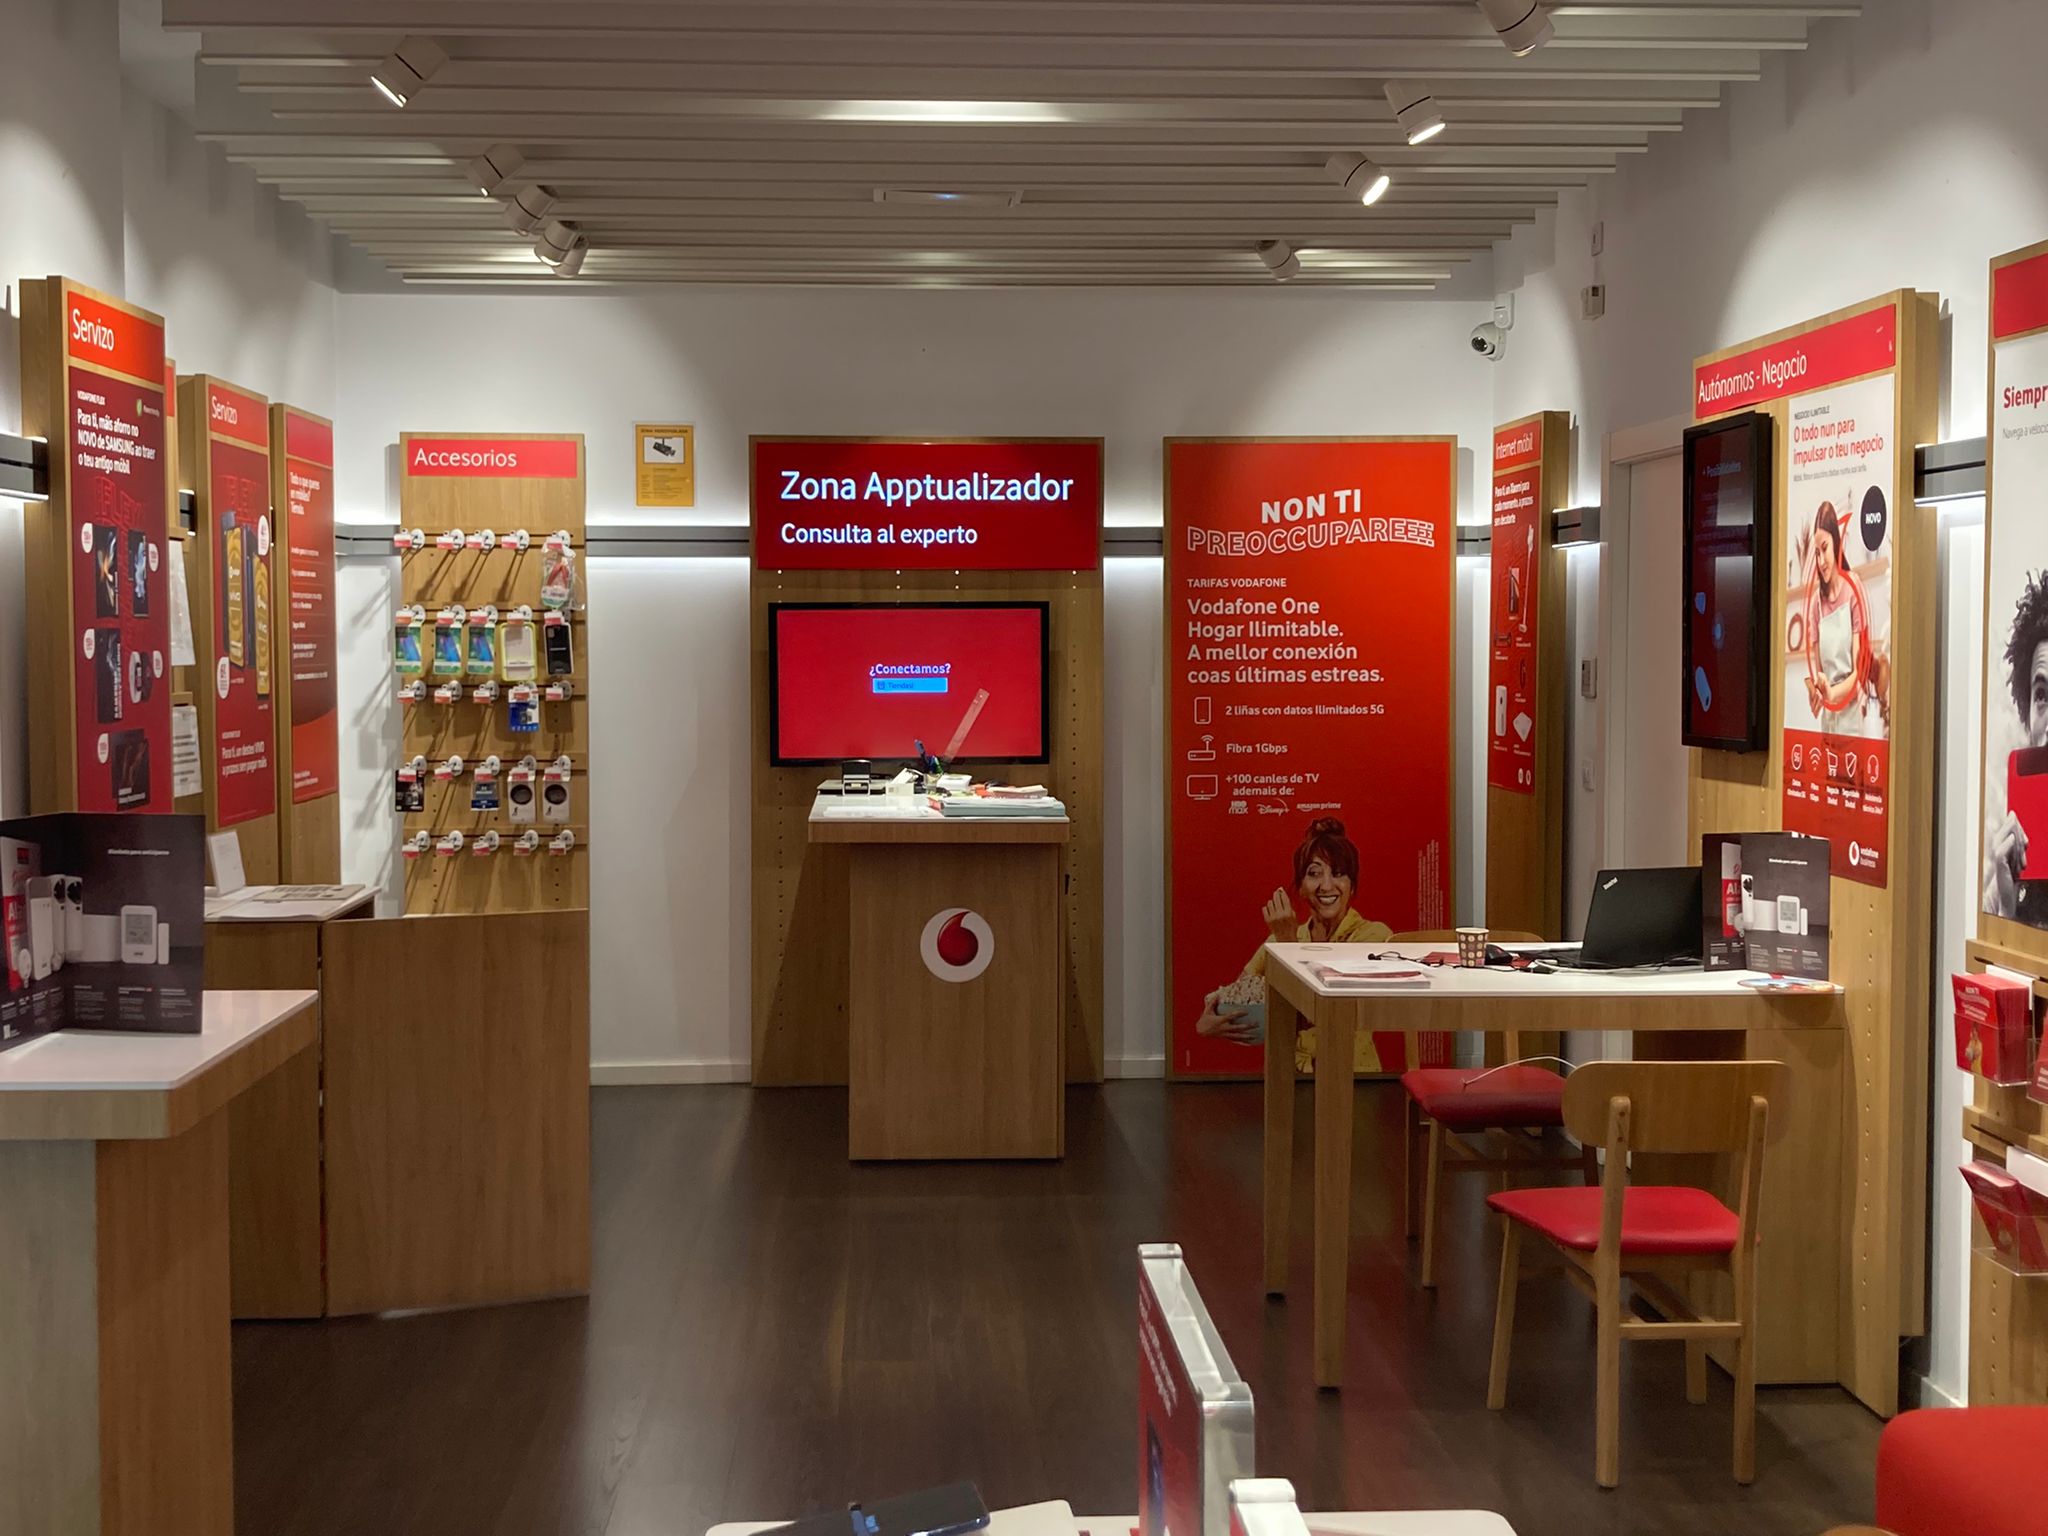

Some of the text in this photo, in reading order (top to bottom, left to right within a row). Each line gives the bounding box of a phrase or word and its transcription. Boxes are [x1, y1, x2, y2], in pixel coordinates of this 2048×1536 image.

[72, 308, 115, 351] Servizo
[1698, 370, 1754, 404] Autónomos
[1762, 350, 1807, 389] Negocio
[211, 395, 238, 425] Servizo
[1794, 408, 1811, 420] NEGOCIO
[77, 408, 91, 426] Para
[131, 425, 139, 437] no
[1794, 419, 1855, 443] O todo nun para
[78, 429, 97, 448] NOVO
[97, 434, 105, 449] de
[105, 435, 134, 456] SAMSUNG
[135, 445, 142, 457] ao
[1496, 432, 1534, 460] Internet móbil
[1793, 434, 1883, 468] impulsar o teu negocio
[78, 453, 83, 466] o
[83, 452, 94, 468] teu
[94, 455, 113, 474] antigo
[414, 448, 518, 468] Accesorios
[780, 471, 1074, 507] Zona Apptualizador
[1261, 488, 1361, 524] NON TI
[1865, 512, 1882, 524] NOVO
[781, 522, 978, 548] Consulta al experto
[1187, 578, 1287, 588] TARIFAS VODAFONE
[1187, 598, 1320, 615] Vodafone One
[1188, 621, 1344, 642] Hogar Ilimitable.
[1187, 642, 1358, 660] A mellor conexión
[869, 663, 951, 677] ¿Conectamos?
[1187, 665, 1385, 683] coas últimas estreas.
[1225, 706, 1232, 715] 2
[1234, 705, 1260, 715] liñas
[1262, 706, 1281, 715] con
[1283, 705, 1313, 715] datos
[1370, 705, 1384, 714] 5G
[1226, 743, 1288, 756] Fibra 1Gbps
[1226, 774, 1251, 784] +100
[1290, 774, 1303, 783] de
[1305, 774, 1319, 783] TV
[1233, 787, 1295, 796] ademais de:
[1320, 802, 1342, 810] prime
[1860, 847, 1879, 859] vodafone
